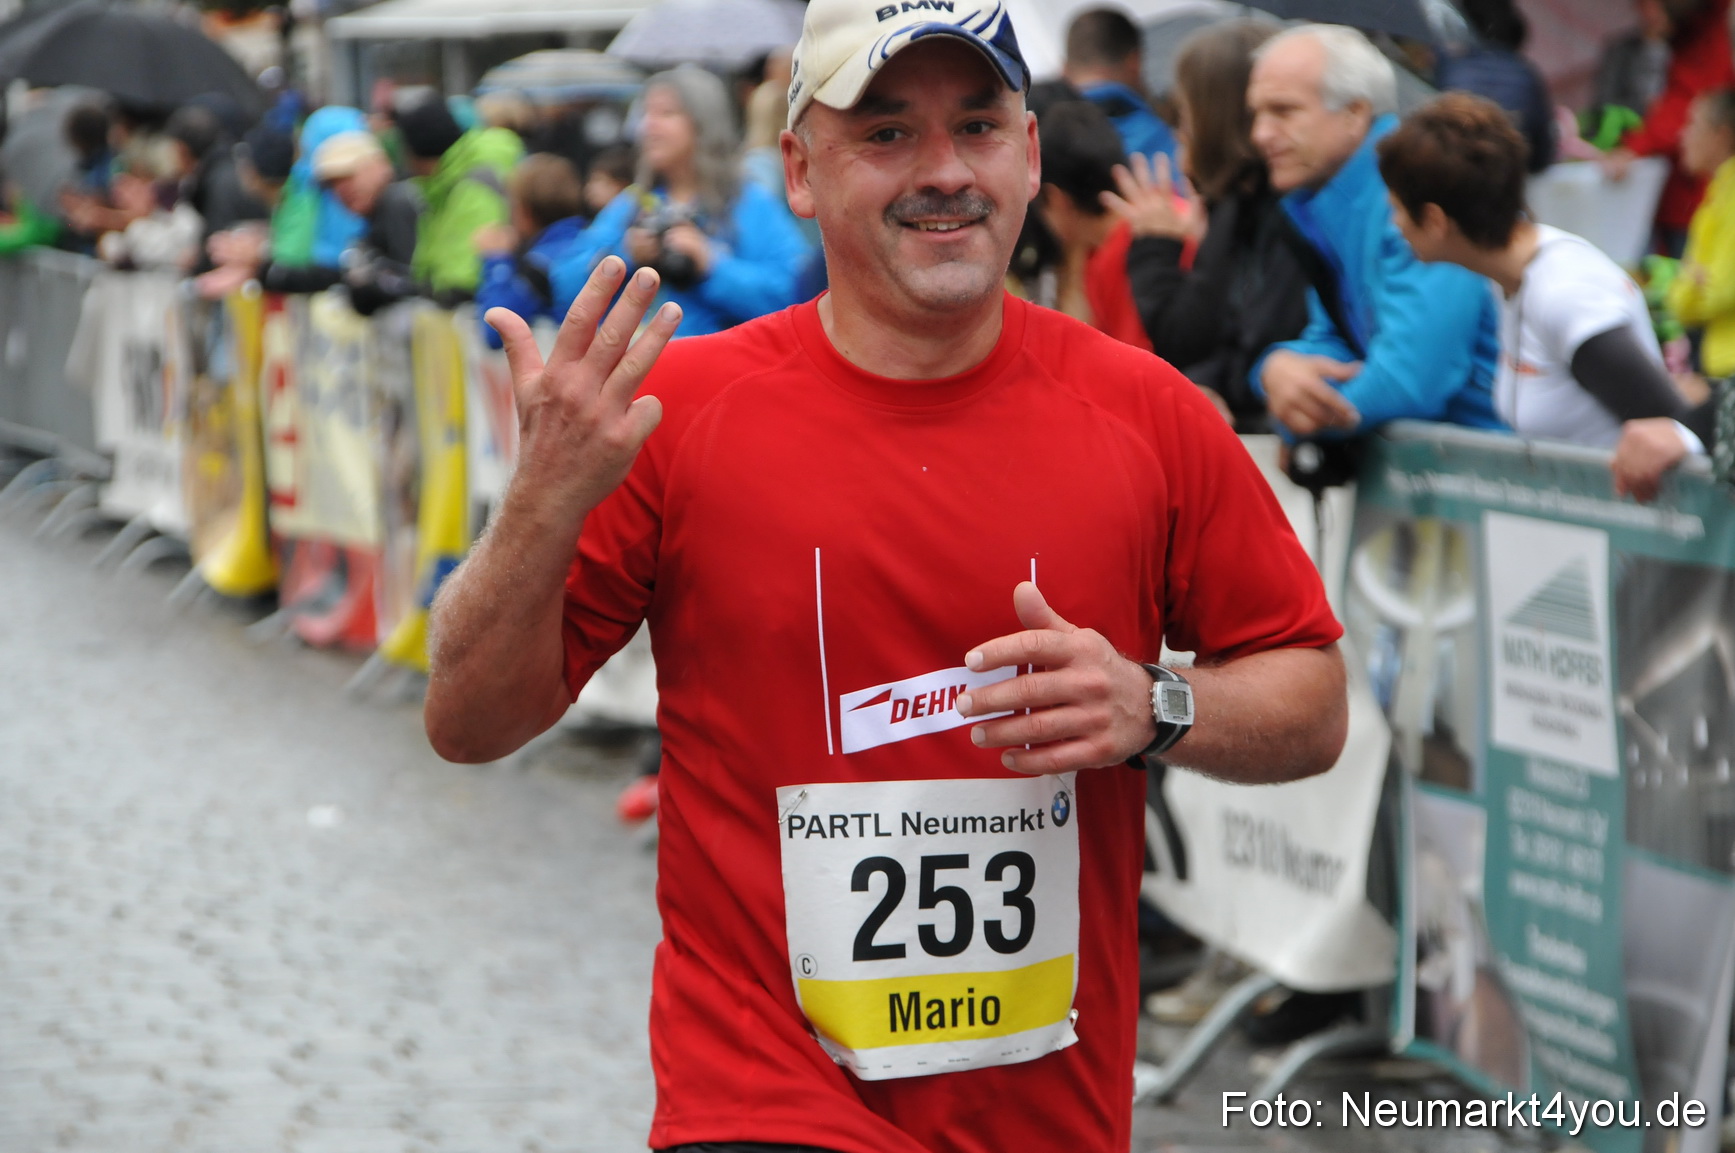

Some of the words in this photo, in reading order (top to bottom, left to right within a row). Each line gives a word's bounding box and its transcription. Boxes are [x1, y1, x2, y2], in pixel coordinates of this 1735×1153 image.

[875, 0, 954, 23] BMW
[787, 812, 892, 839] PARTL
[901, 808, 1045, 837] Neumarkt
[850, 850, 1036, 962] 253
[801, 956, 812, 975] C
[888, 987, 1001, 1033] Mario
